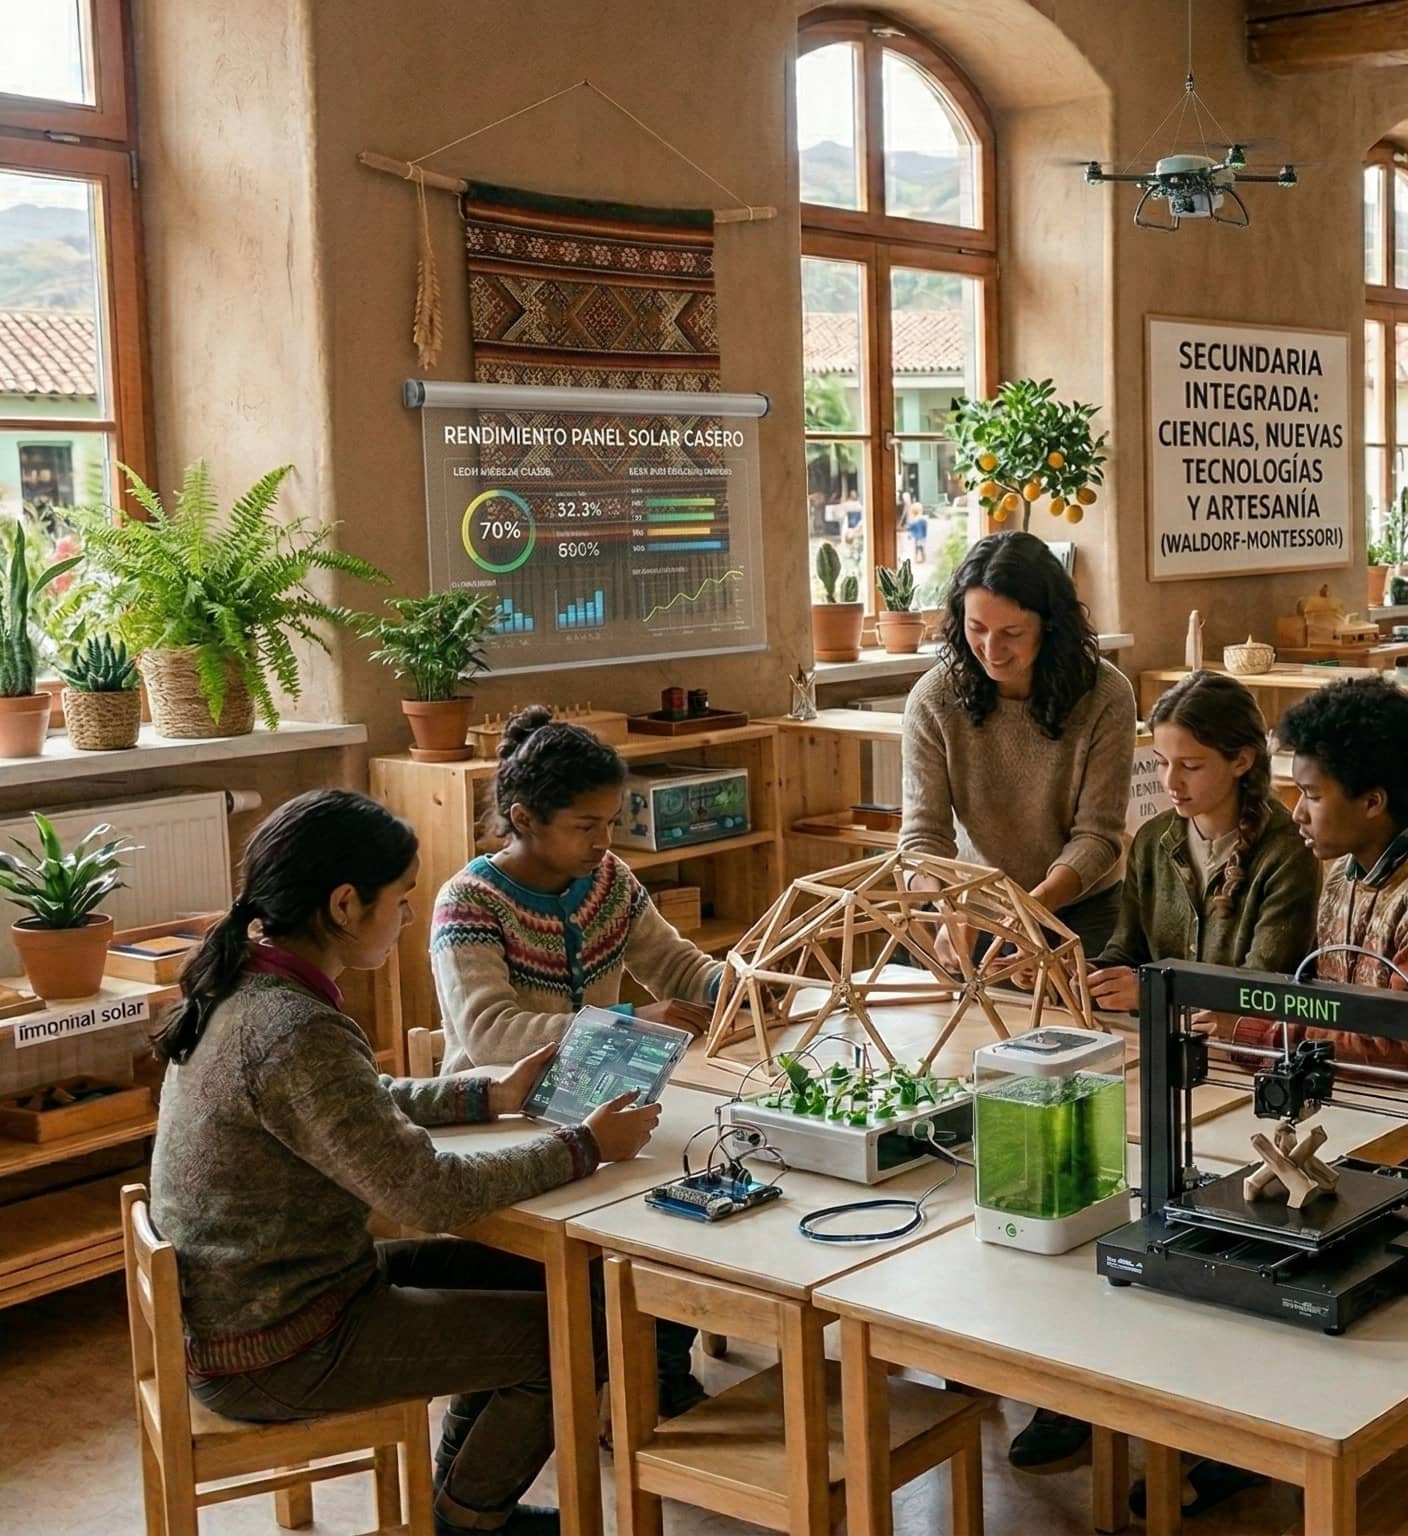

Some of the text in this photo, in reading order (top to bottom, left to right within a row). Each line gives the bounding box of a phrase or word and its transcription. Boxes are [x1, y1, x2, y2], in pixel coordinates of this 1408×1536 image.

[1179, 341, 1323, 376] SECUNDARIA
[1185, 381, 1319, 413] INTEGRADA:
[444, 425, 744, 448] RENDIMIENTO PANEL SOLAR CASERO
[1158, 420, 1343, 451] CIENCIAS, NUEVAS
[1182, 453, 1323, 484] TECNOLOGÍAS
[557, 501, 602, 519] 32.3%
[1187, 488, 1320, 521] Y ARTESANÍA
[480, 521, 521, 540] 70%
[1161, 527, 1343, 557] (WALDORF-MONTESSORI)
[101, 1002, 144, 1022] solar
[1240, 988, 1341, 1022] ECD PRINT
